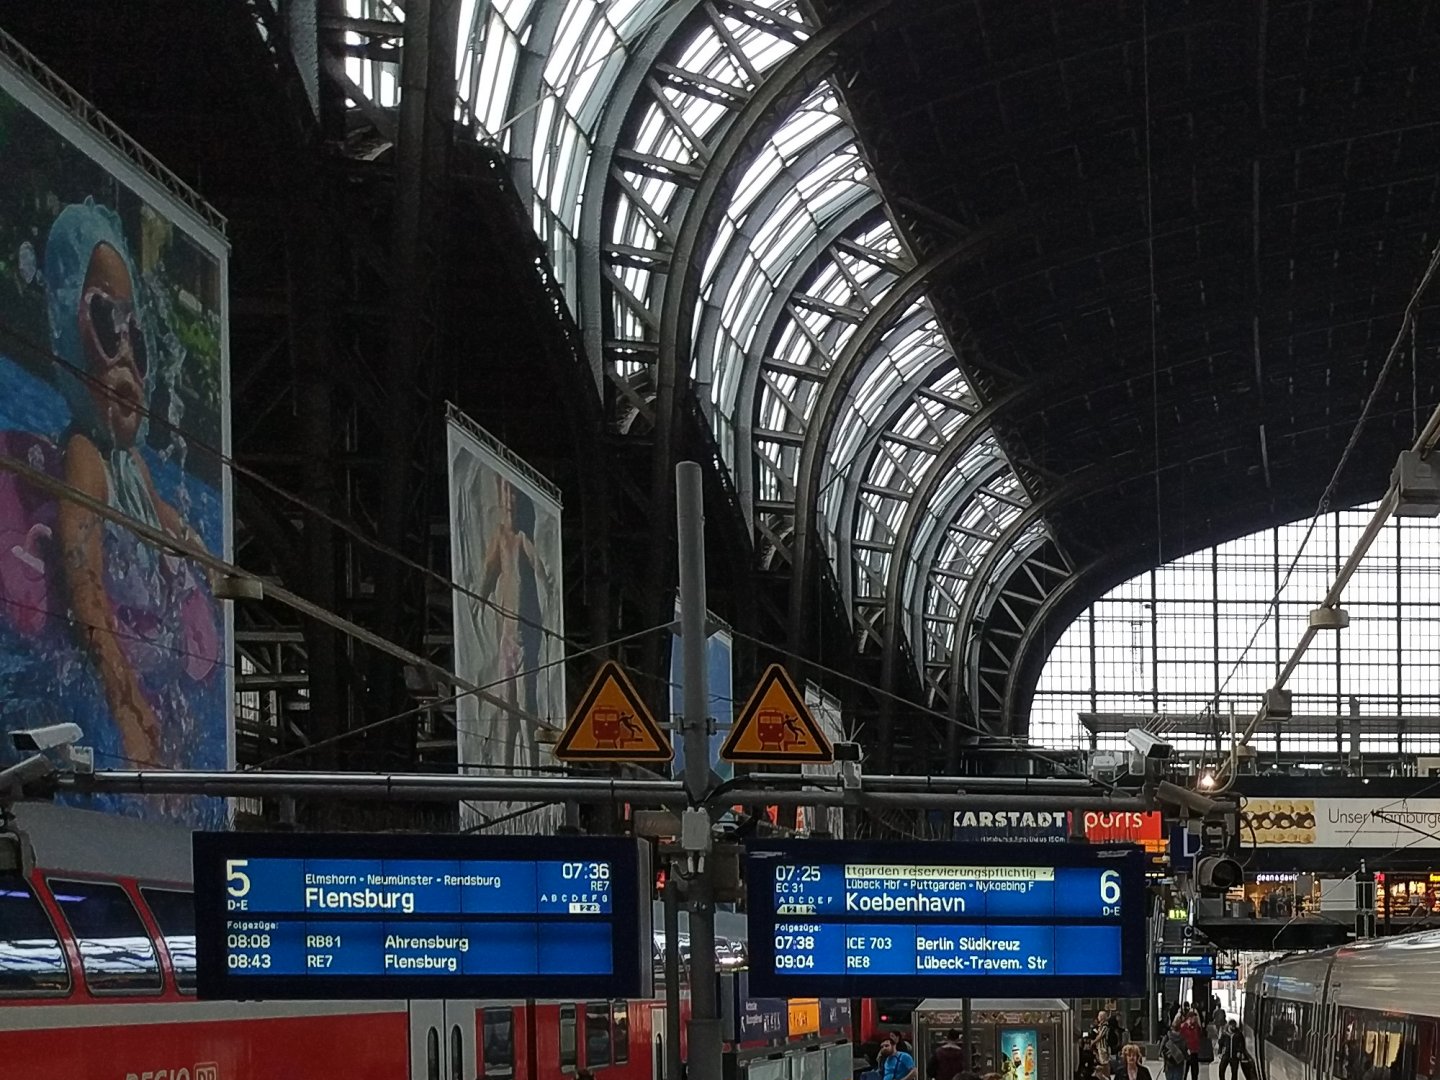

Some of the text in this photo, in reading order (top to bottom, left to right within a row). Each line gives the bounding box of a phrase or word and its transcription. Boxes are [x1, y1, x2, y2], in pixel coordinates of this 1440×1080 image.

[953, 811, 1143, 833] KARSTADT ports
[1328, 808, 1366, 824] Unser
[226, 859, 250, 897] 5
[562, 862, 610, 880] 07:36
[775, 866, 821, 882] 07:25
[305, 874, 501, 888] Elmshorn Neumünster Rendsburg
[590, 881, 609, 892] RE7
[775, 883, 789, 893] EC
[846, 879, 1034, 894] Lübeck Hbf Puttgarden Nykoebing F
[1100, 869, 1120, 905] 6
[305, 887, 415, 914] Flensburg
[846, 892, 965, 912] Koebenhavn
[227, 921, 279, 931] Folgezüge:
[774, 923, 822, 933] Folgezüge:
[227, 934, 469, 952] 08:08 RB81 Ahrensburg
[775, 936, 1020, 951] 07:38 ICE 703 Berlin Südkreuz
[228, 954, 457, 972] 08:43 RE7 Flensburg
[775, 955, 1048, 970] 09:04 RE8 Lübeck-Travem. Str
